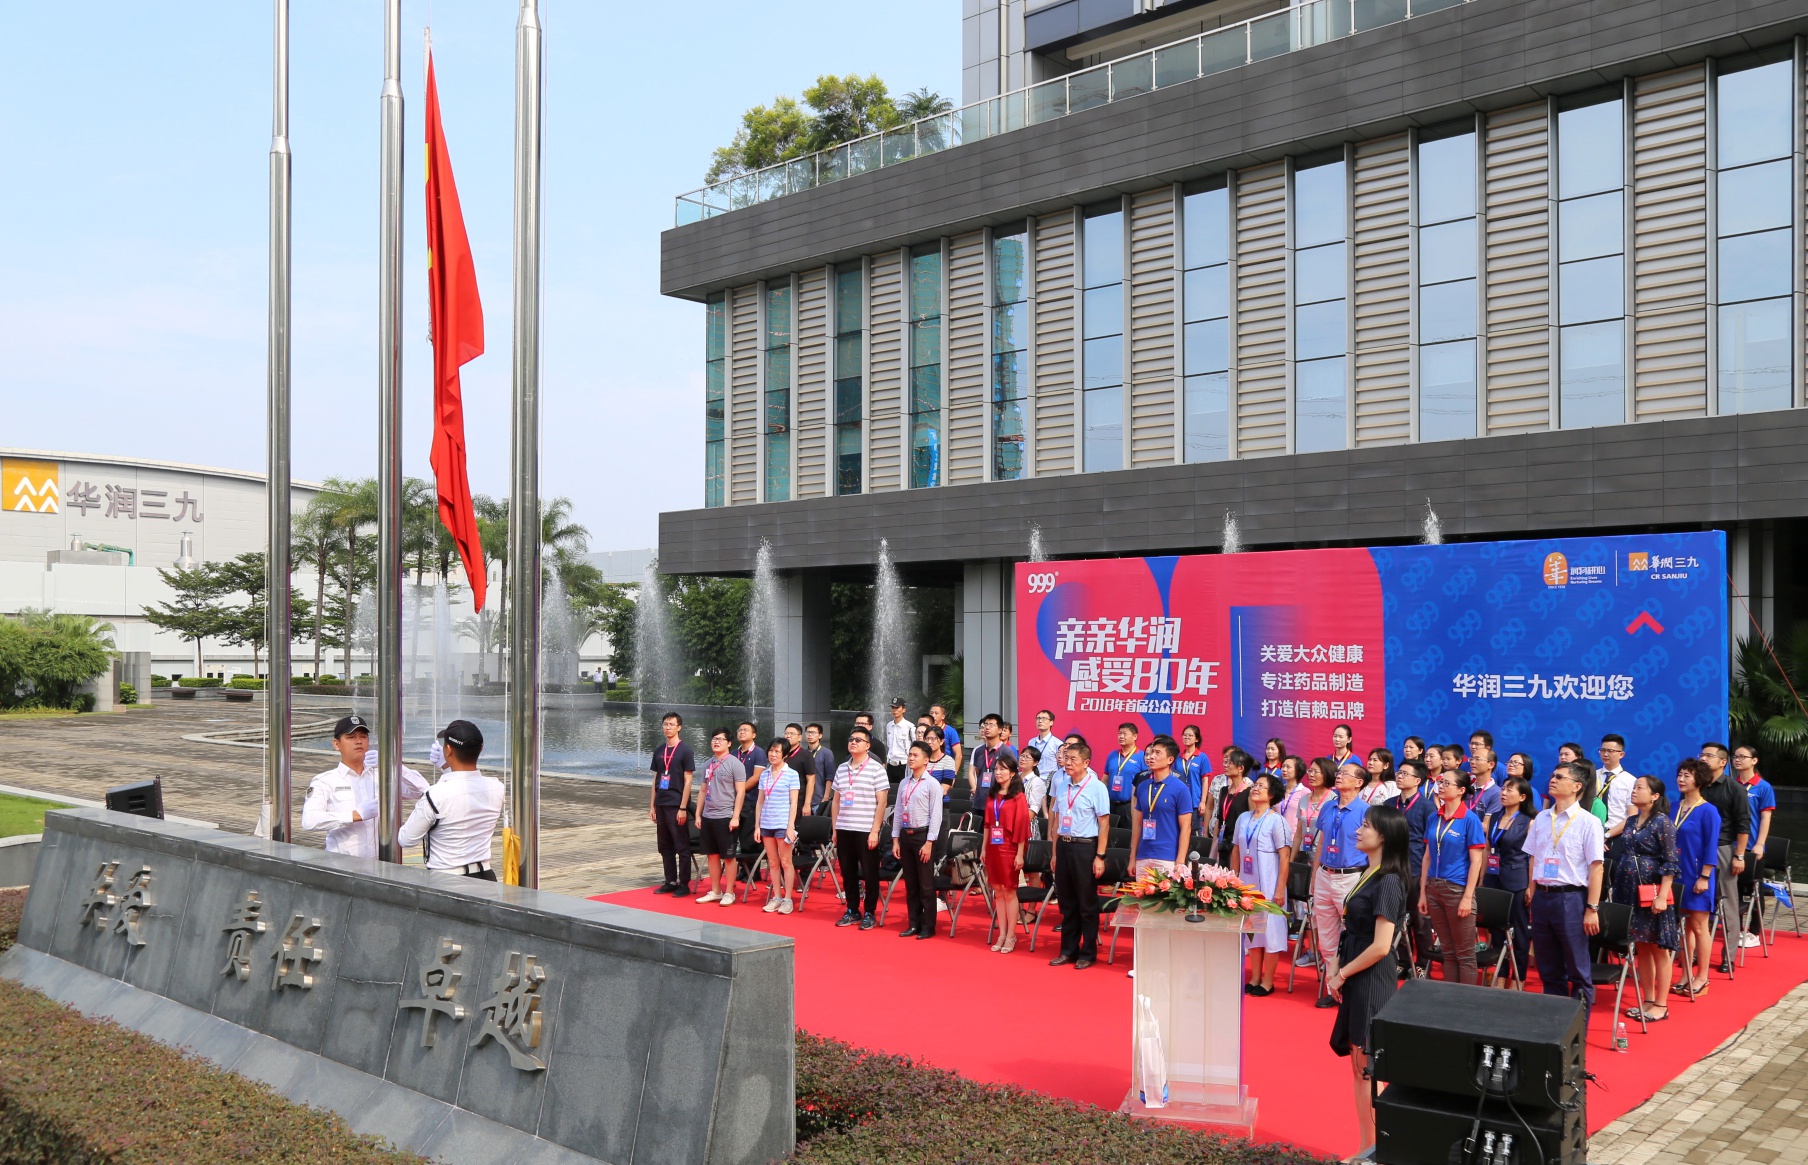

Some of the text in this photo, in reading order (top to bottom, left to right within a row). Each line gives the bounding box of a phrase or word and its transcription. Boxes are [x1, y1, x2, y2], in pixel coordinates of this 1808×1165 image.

[67, 481, 204, 522] 华润三九
[1662, 572, 1688, 580] SANJIU
[1055, 617, 1182, 660] 亲亲华润
[1261, 644, 1364, 664] 关爱大众健康
[1068, 657, 1221, 711] 感受80年
[1261, 672, 1364, 692] 专注药品制造
[1452, 672, 1634, 700] 华润三九欢迎您
[1080, 698, 1207, 716] 2018年首届公众开放日
[1261, 699, 1365, 720] 打造信赖品牌
[220, 890, 323, 992] 责任
[400, 936, 547, 1071] 卓越
